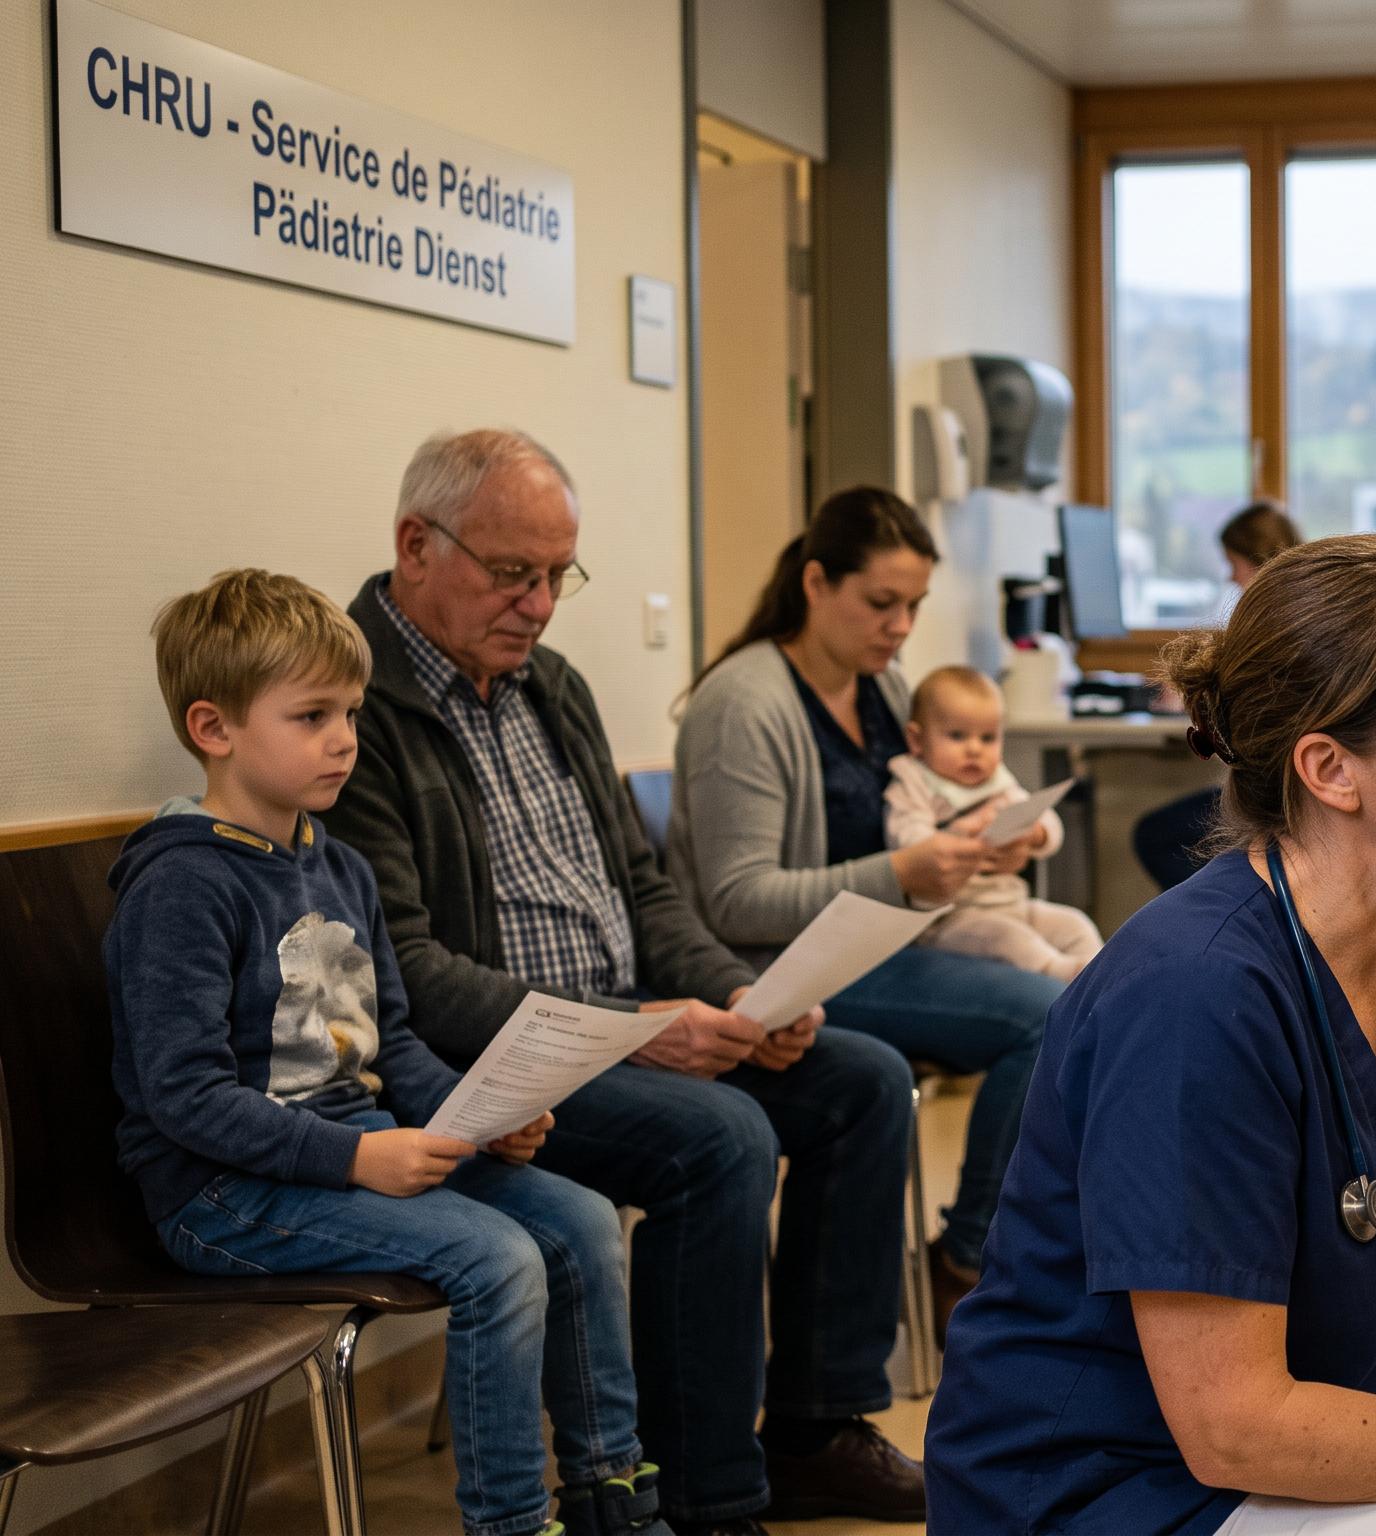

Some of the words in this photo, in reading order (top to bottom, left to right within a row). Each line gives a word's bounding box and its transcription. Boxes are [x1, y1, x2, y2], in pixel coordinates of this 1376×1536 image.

[86, 46, 212, 139] CHRU
[226, 119, 240, 134] -
[251, 99, 380, 189] Service
[391, 149, 429, 203] de
[439, 160, 561, 244] Pédiatrie
[252, 181, 403, 271] Pädiatrie
[415, 227, 508, 297] Dienst
